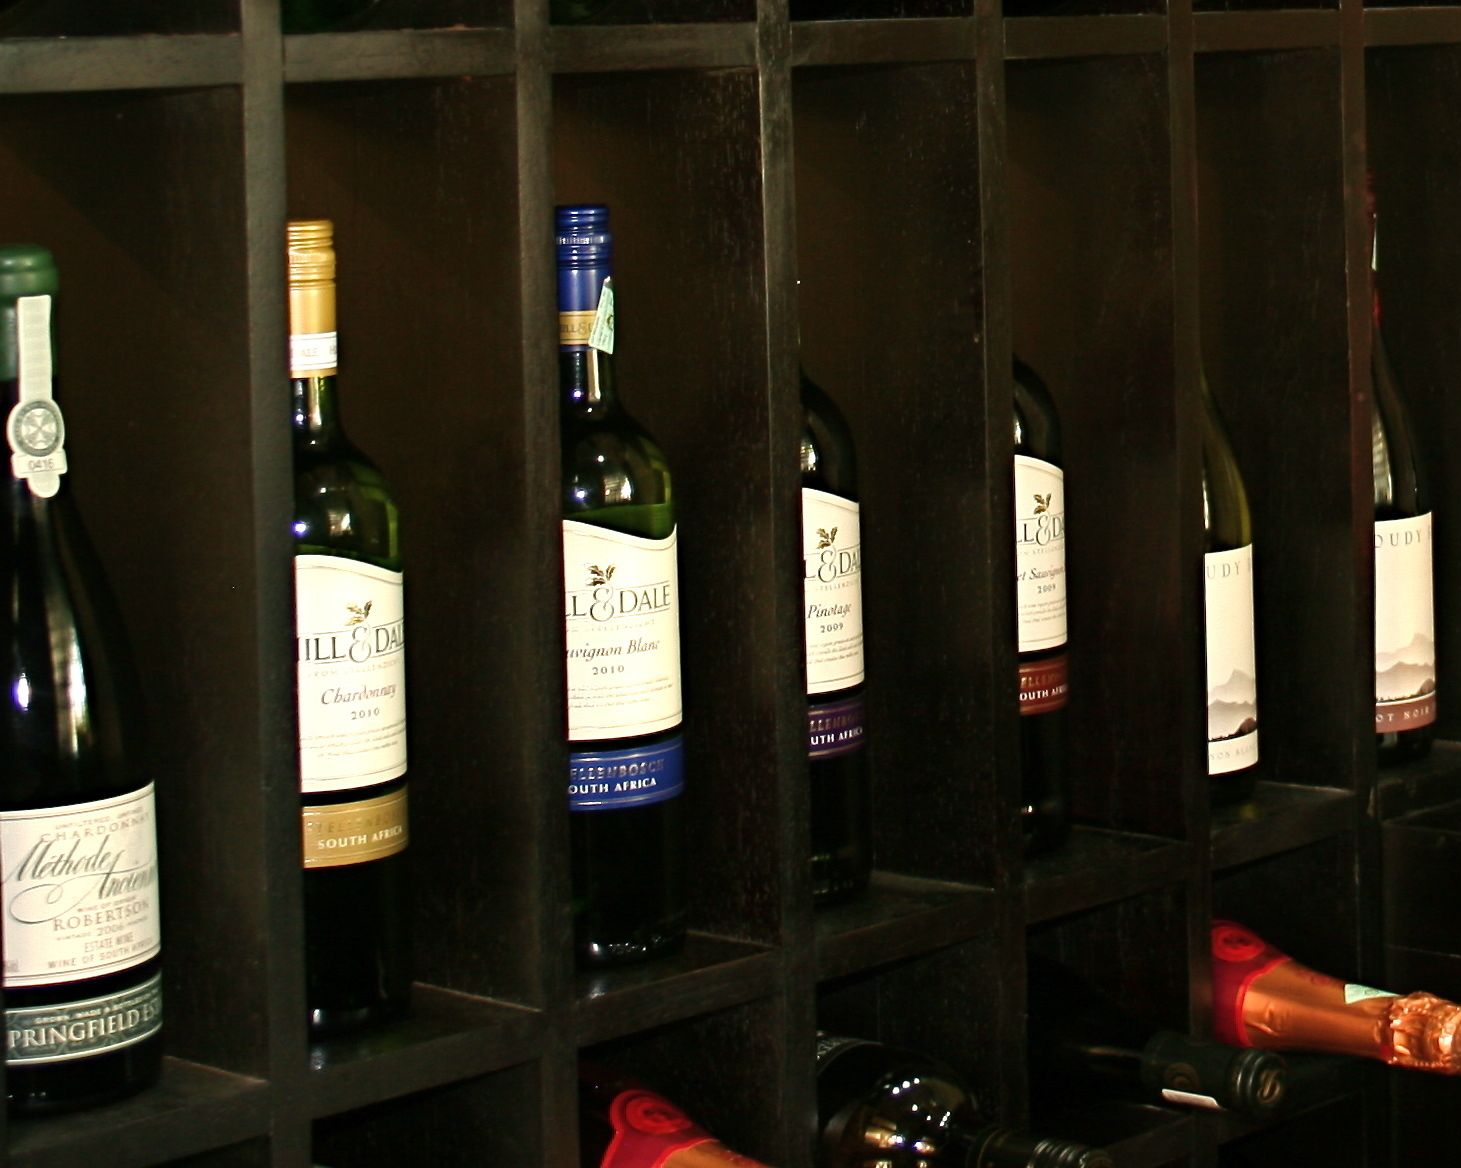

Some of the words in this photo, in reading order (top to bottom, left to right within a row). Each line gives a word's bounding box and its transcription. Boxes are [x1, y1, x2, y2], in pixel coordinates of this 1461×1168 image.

[1035, 514, 1052, 546] &
[817, 549, 837, 583] &
[589, 587, 615, 622] &
[619, 584, 672, 615] DALE
[807, 603, 852, 619] Pinotage
[820, 622, 844, 634] 2009
[348, 625, 372, 664] &
[626, 636, 661, 655] Blanc
[591, 664, 625, 676] 2010
[320, 684, 396, 705] Chardonnay
[350, 707, 381, 721] 2010
[614, 777, 657, 793] AFRICA
[318, 834, 368, 850] SOUTH
[17, 834, 112, 882] Méthode
[53, 899, 150, 932] ROBERTSON
[48, 958, 77, 969] WINE
[83, 953, 95, 965] OF
